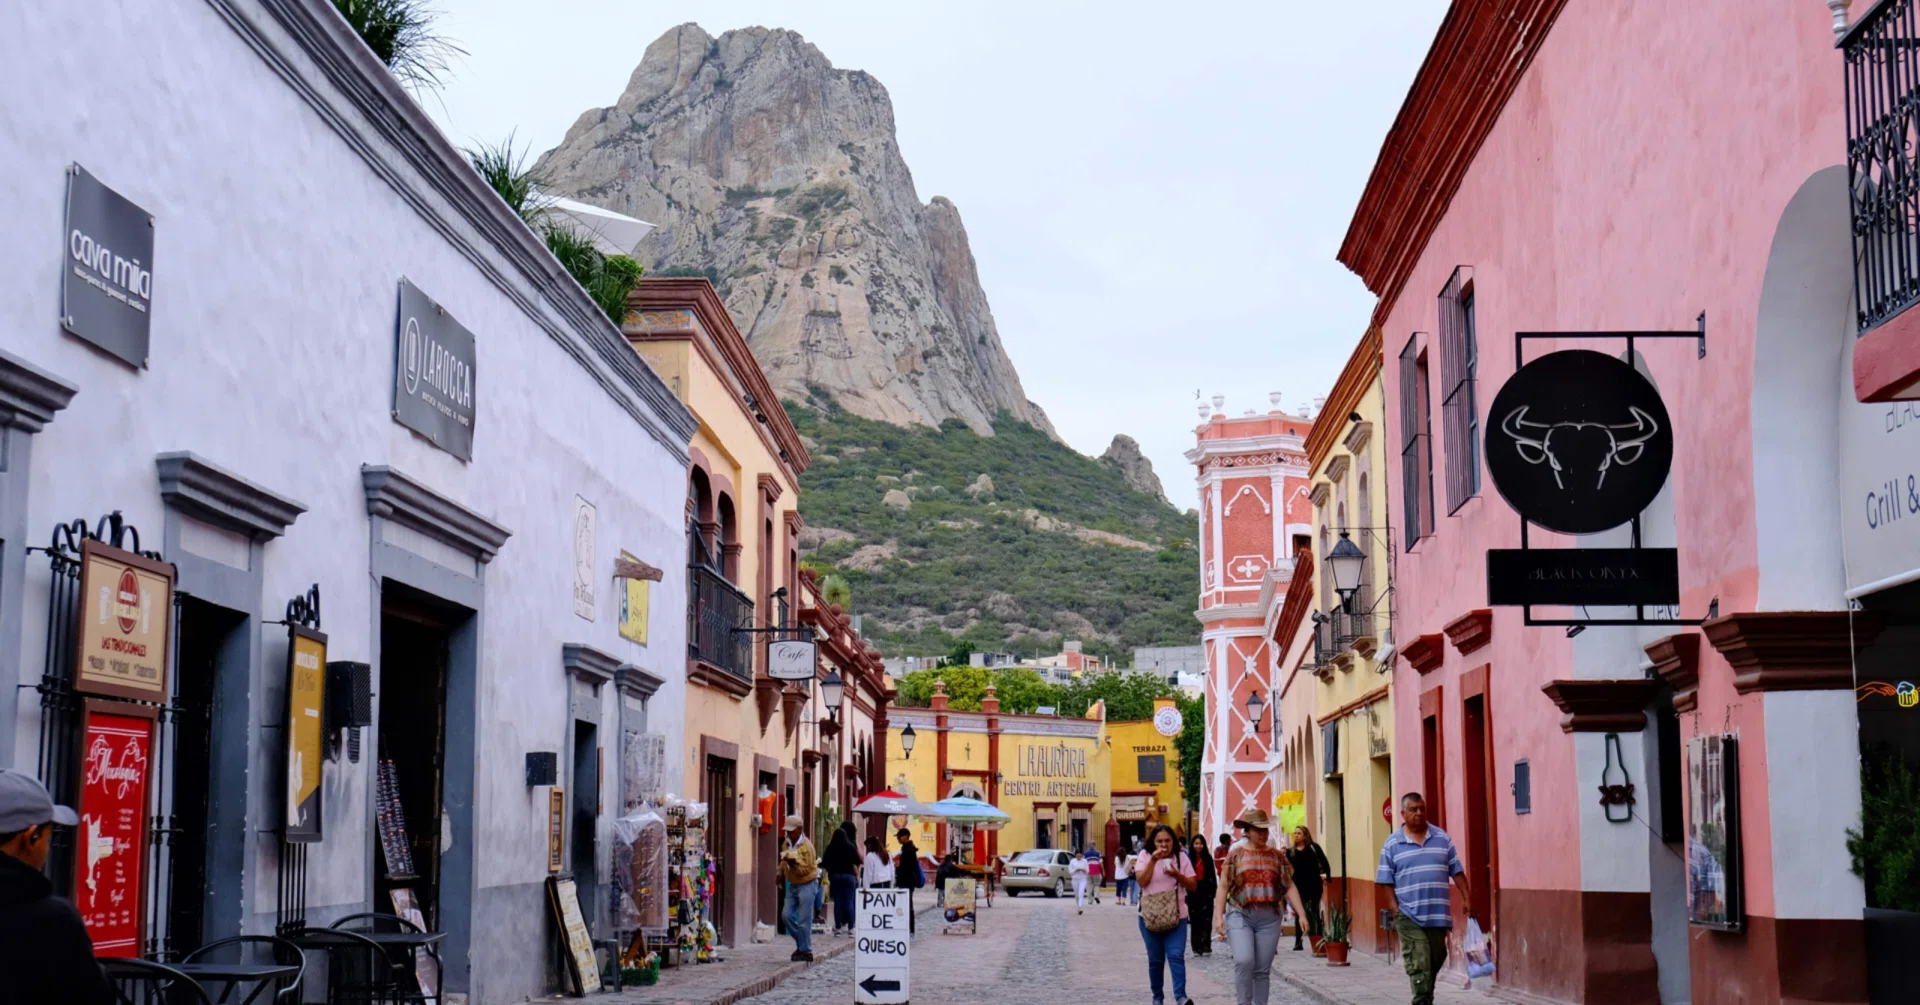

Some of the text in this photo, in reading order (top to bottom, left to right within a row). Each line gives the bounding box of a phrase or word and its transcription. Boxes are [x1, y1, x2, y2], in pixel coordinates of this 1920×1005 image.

[71, 229, 110, 279] cava
[422, 334, 471, 409] LAROCCA
[1866, 474, 1920, 530] Grill &
[1528, 566, 1640, 580] BLACK ONYX
[775, 644, 809, 664] Café
[1132, 745, 1167, 753] TERRAZA
[1004, 780, 1099, 798] CENTRO ARTESANAL
[862, 889, 897, 910] PAN
[871, 914, 894, 930] DE
[858, 937, 907, 957] QUESO
